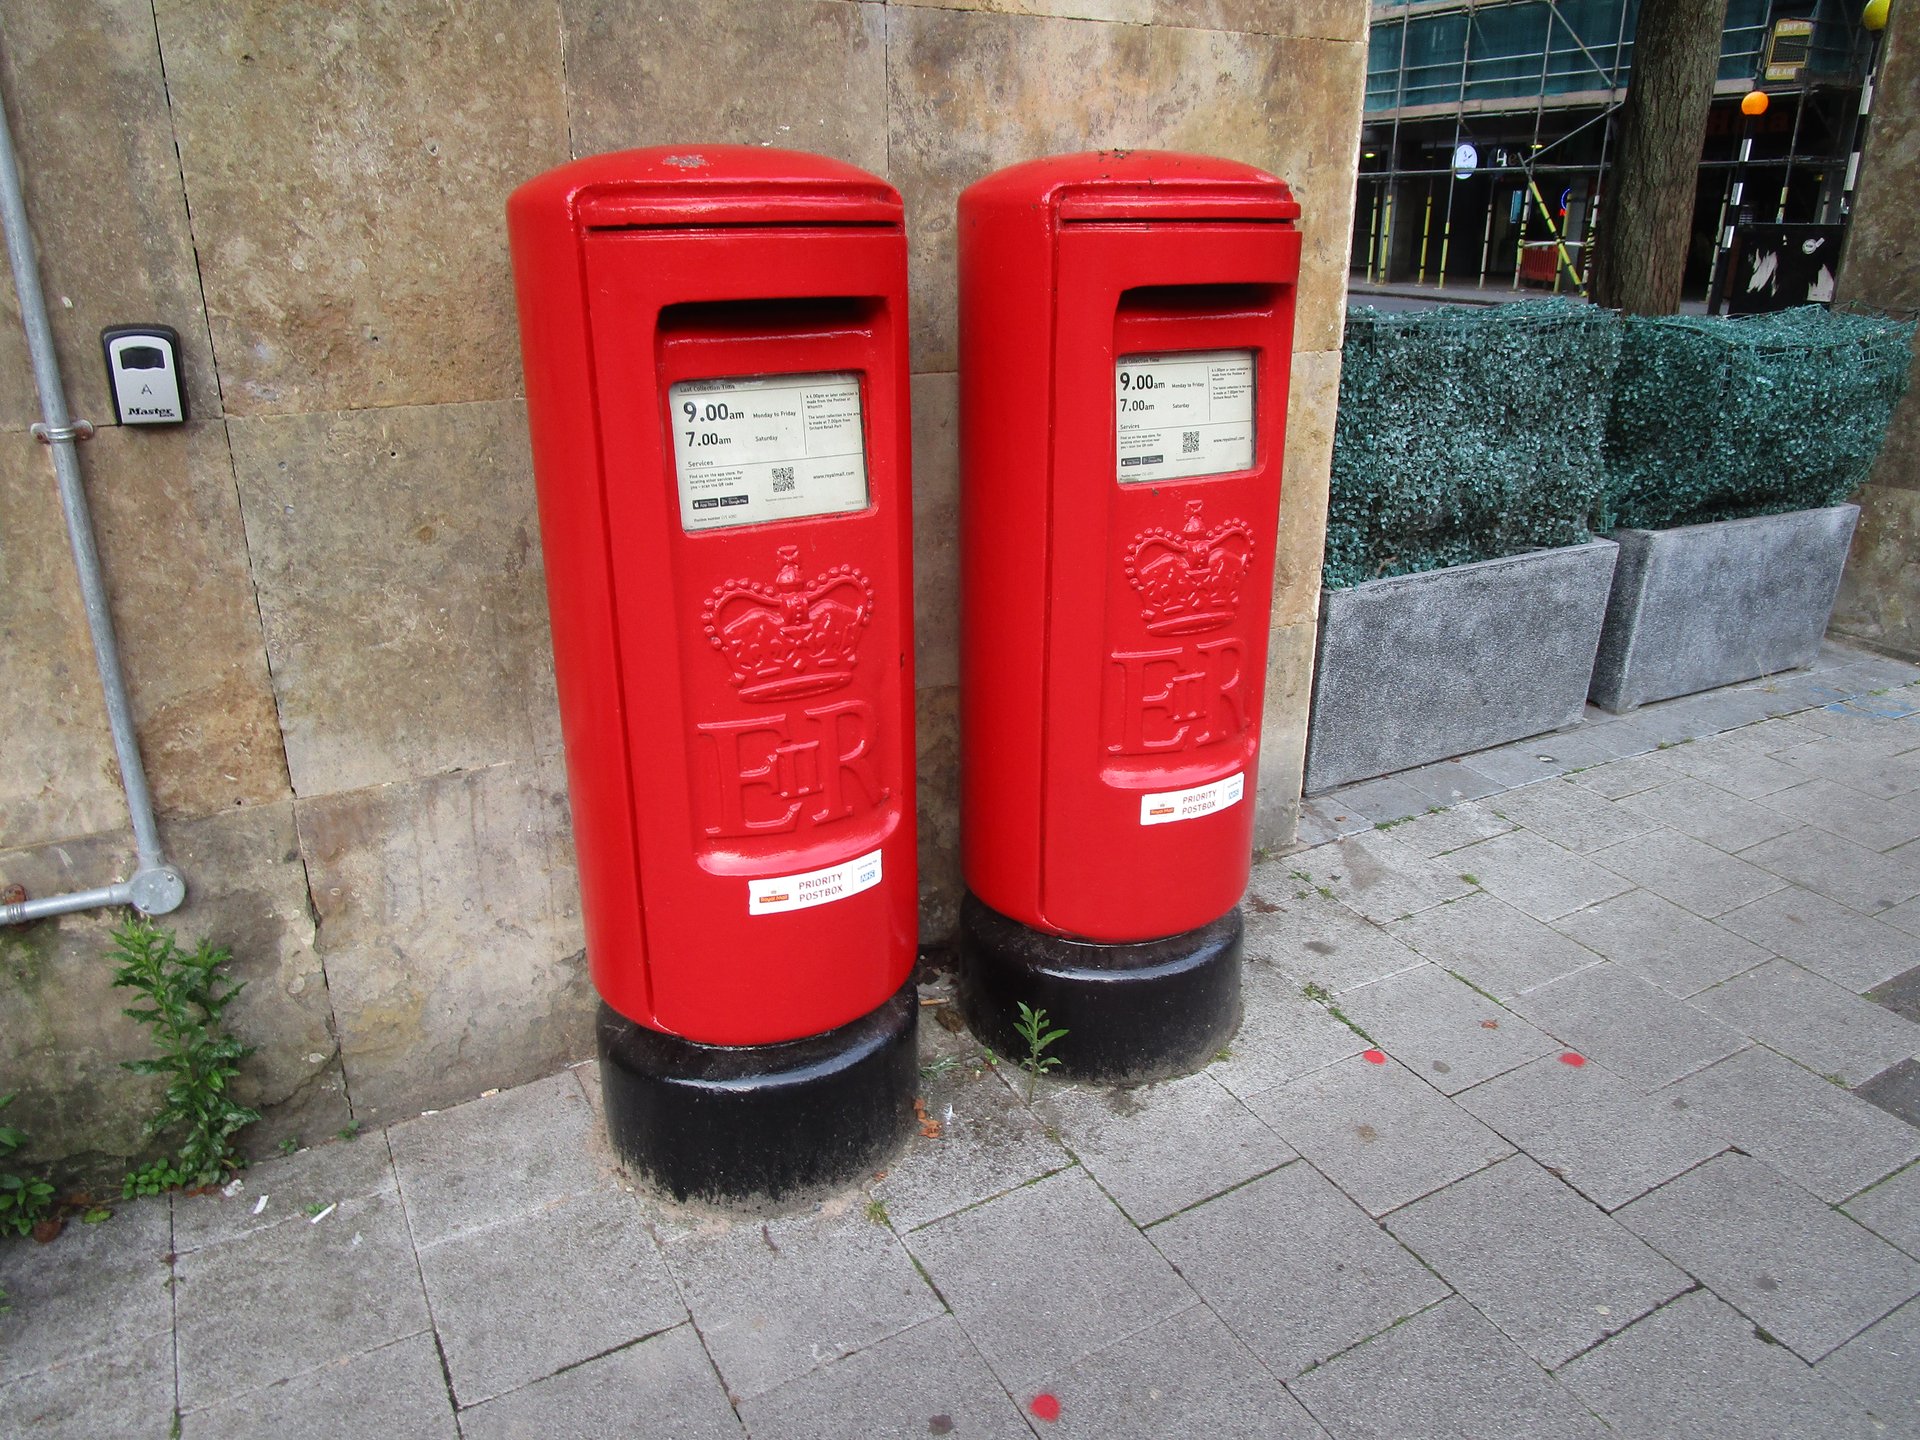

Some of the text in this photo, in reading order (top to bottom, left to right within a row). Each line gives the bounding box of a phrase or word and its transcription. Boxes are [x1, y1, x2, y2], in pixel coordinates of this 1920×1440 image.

[1120, 372, 1165, 391] 9.00am
[684, 402, 744, 423] 9.00am
[1120, 399, 1154, 412] 7.00am
[686, 432, 731, 447] 7.00am
[813, 471, 855, 479] www.royalmail.com
[1183, 790, 1217, 804] PRIORITY
[1182, 800, 1216, 814] POSTBOX
[799, 872, 843, 890] PRIORITY
[800, 885, 843, 902] POSTBOX
